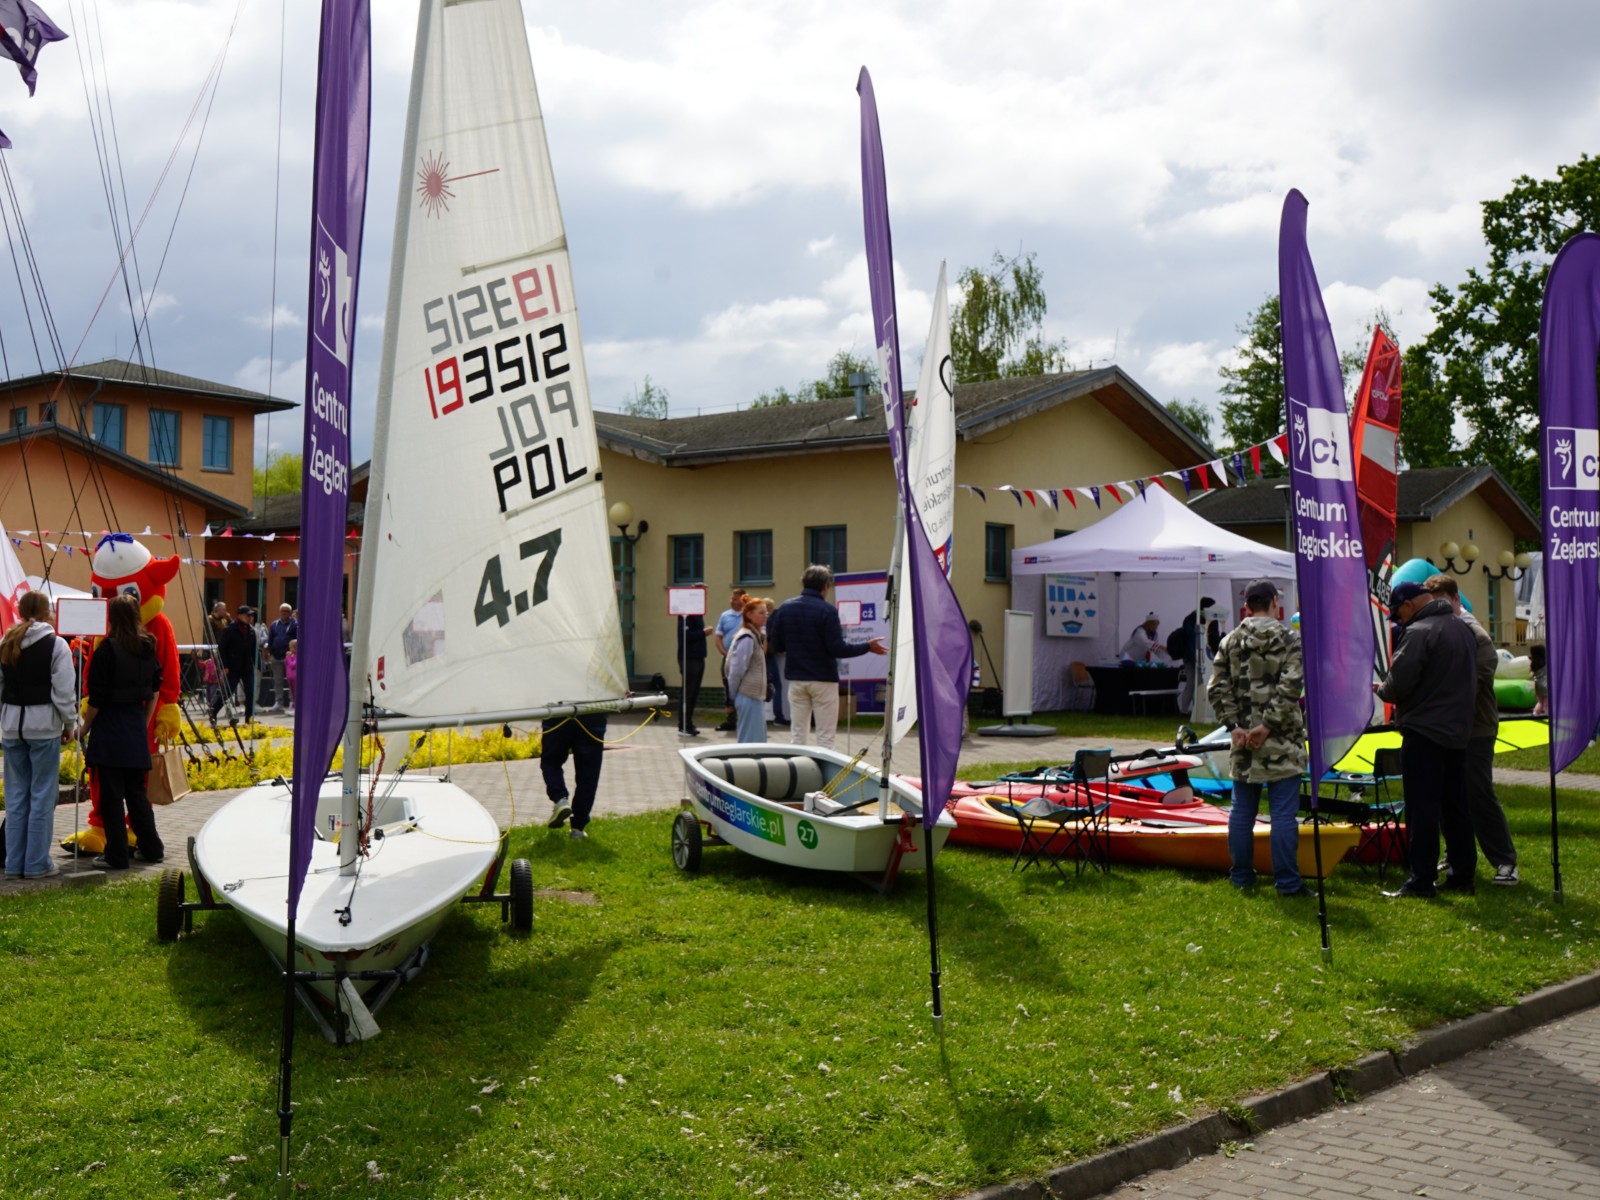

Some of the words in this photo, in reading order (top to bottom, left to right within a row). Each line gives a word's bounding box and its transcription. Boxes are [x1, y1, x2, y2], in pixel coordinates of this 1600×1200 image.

[424, 323, 570, 419] 193512
[493, 437, 588, 513] POL
[1297, 521, 1363, 561] Żeglarskie
[1551, 532, 1599, 565] Żeglars
[474, 527, 562, 628] 4.7
[695, 781, 781, 838] centrumzeglarskie.pl
[799, 825, 815, 843] 27
